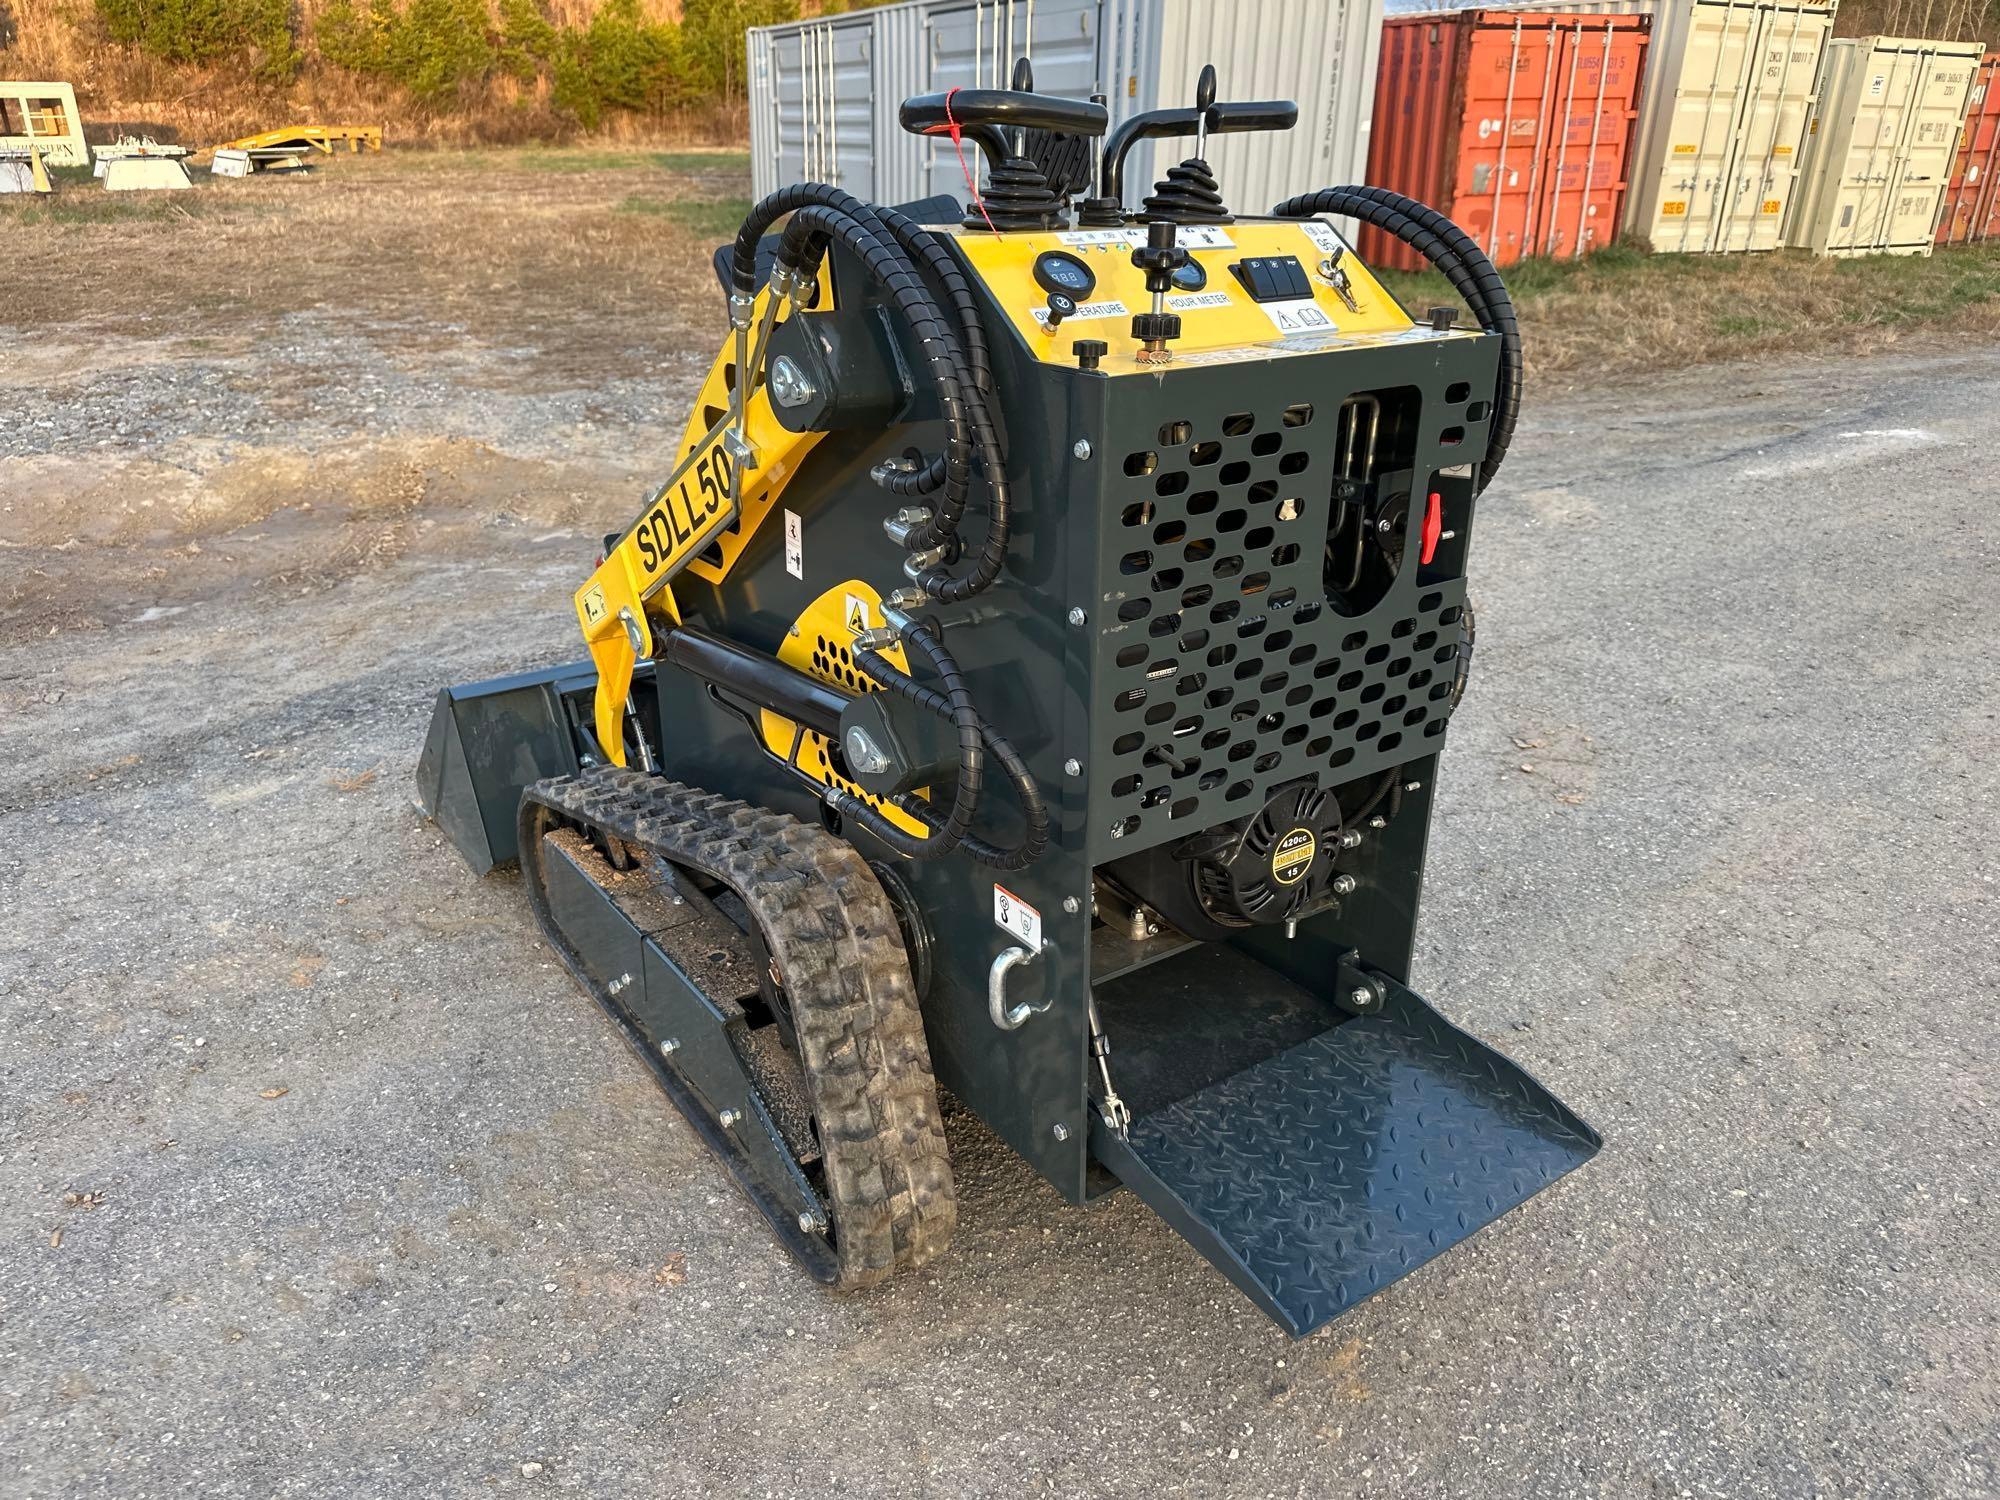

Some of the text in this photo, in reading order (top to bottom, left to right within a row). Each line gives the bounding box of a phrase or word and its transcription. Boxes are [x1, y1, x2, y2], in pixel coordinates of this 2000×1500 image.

[1168, 294, 1230, 309] HOUR METER
[636, 444, 733, 573] SDLL50
[1282, 835, 1307, 848] 420cc
[1287, 867, 1298, 877] 15
